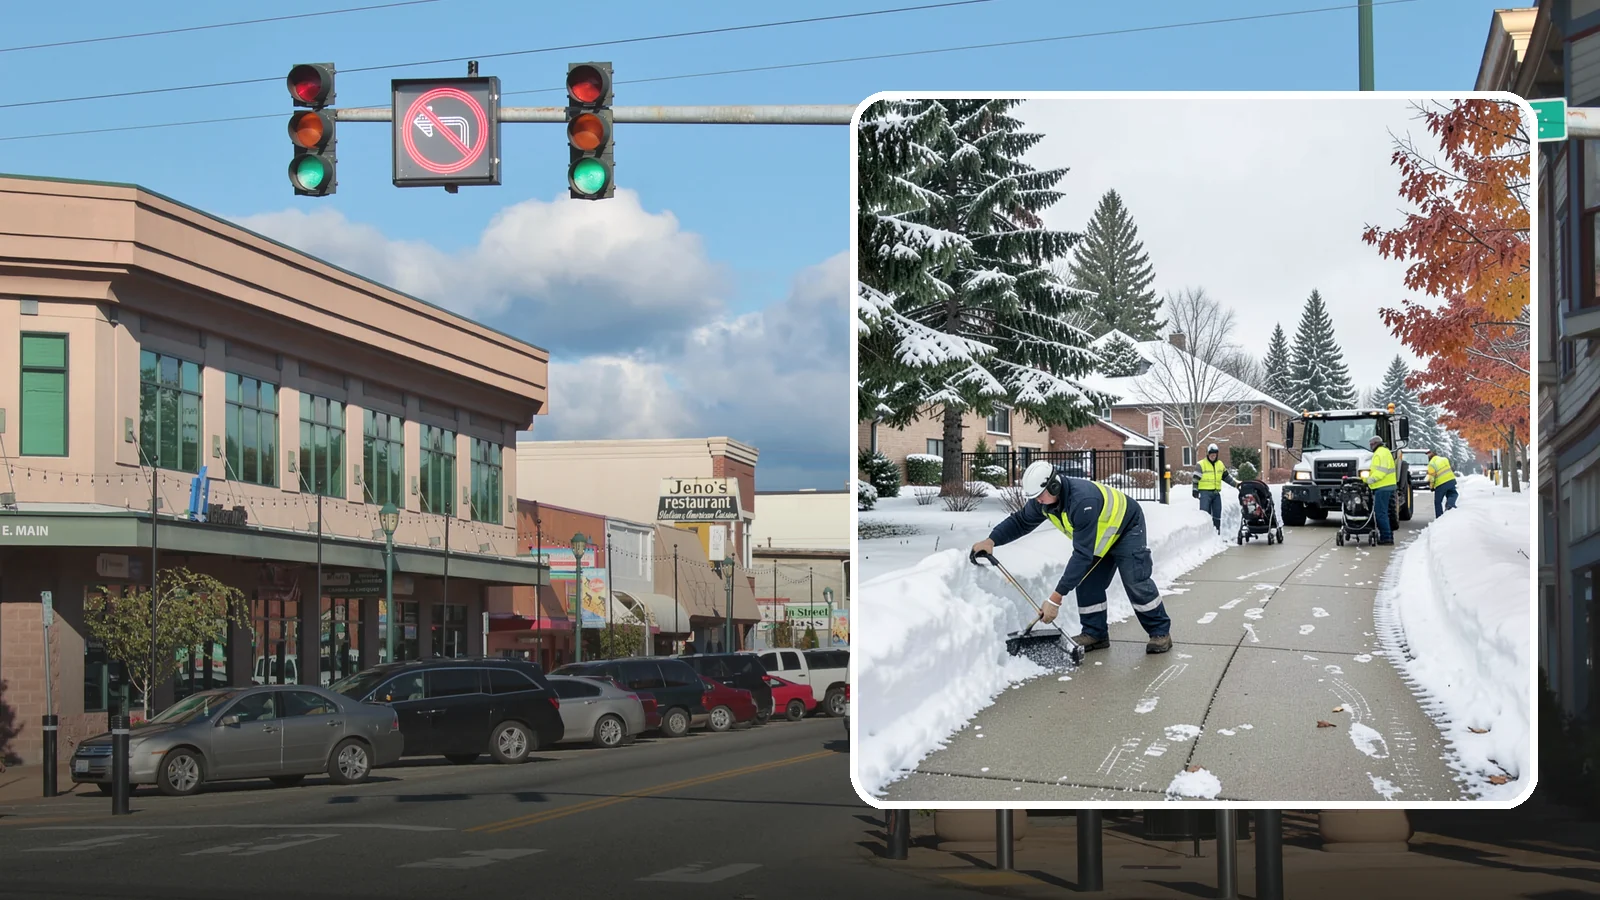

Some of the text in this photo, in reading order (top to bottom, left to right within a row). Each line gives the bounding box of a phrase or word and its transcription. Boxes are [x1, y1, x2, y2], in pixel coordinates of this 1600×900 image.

[669, 480, 727, 494] Jeno's
[665, 496, 731, 509] restaurant
[686, 510, 714, 519] American
[715, 509, 738, 519] Cuisine
[15, 525, 49, 536] MAIN
[785, 607, 794, 617] in
[797, 607, 828, 617] Street
